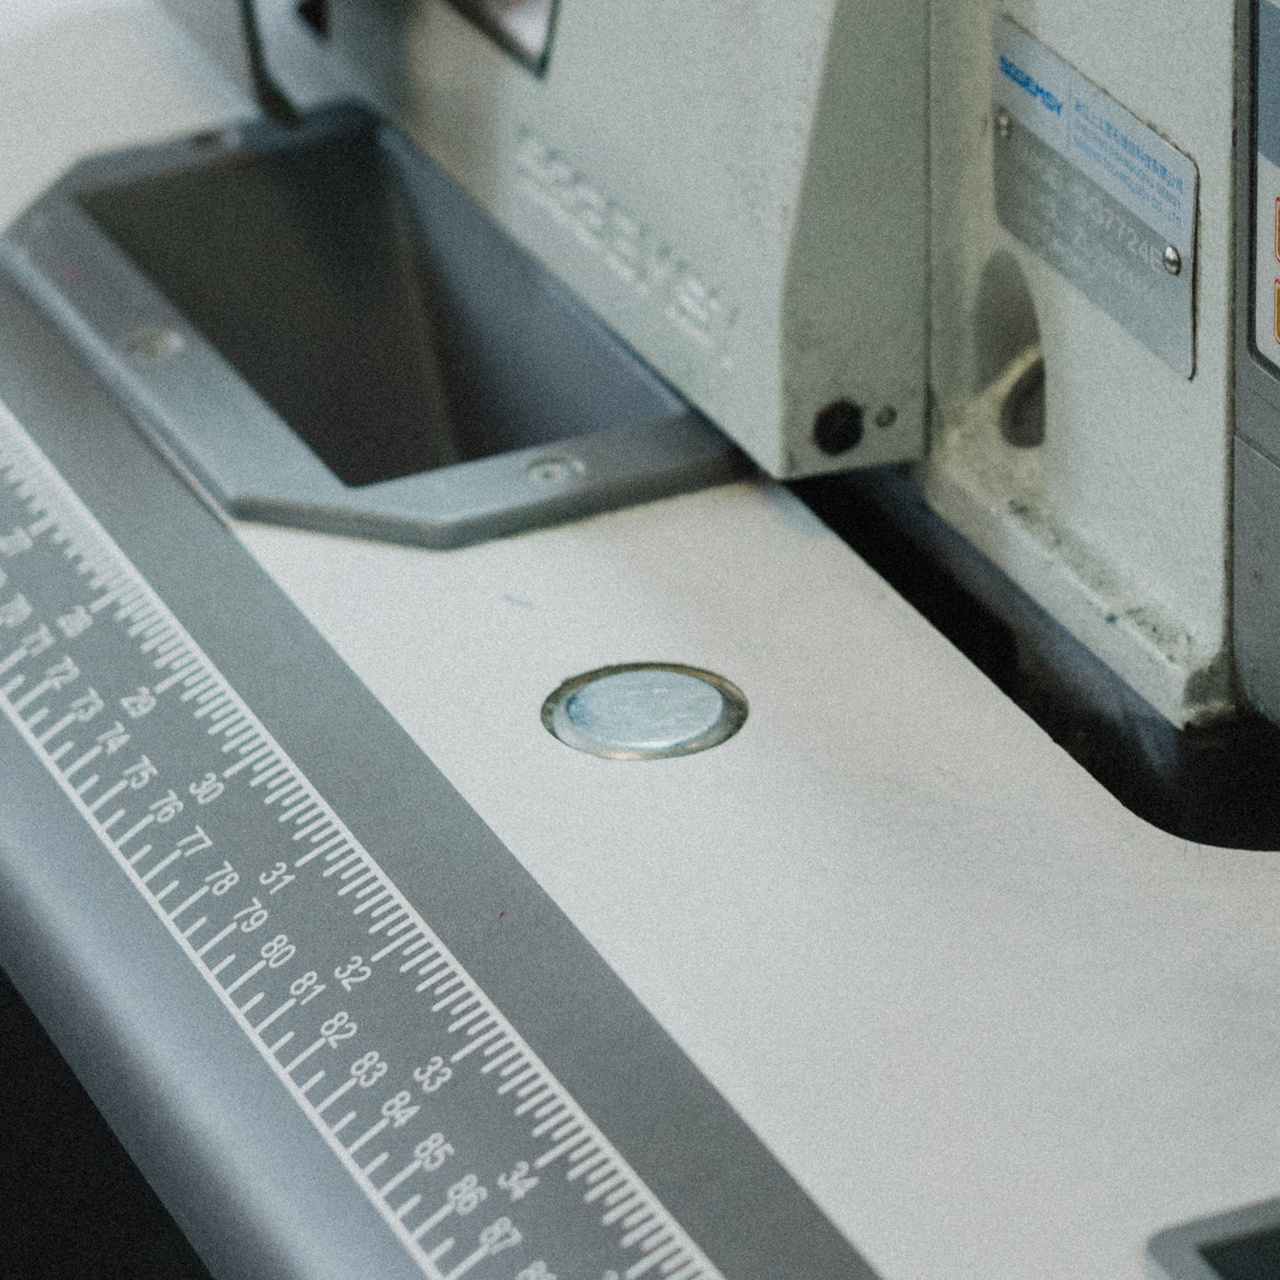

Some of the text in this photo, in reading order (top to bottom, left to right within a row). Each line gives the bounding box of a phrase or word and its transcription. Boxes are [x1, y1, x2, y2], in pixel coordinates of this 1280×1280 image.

[97, 721, 130, 755] 74
[123, 755, 158, 790] 75
[189, 773, 225, 804] 30
[150, 789, 184, 823] 76
[176, 825, 213, 857] 77
[204, 861, 239, 896] 78
[258, 861, 295, 895] 31
[232, 897, 269, 933] 79
[260, 934, 296, 968] 80
[290, 970, 326, 1006] 81
[334, 955, 372, 991] 32
[320, 1011, 358, 1048] 82
[350, 1050, 388, 1088] 83
[414, 1055, 452, 1093] 33
[381, 1090, 420, 1128] 84
[413, 1132, 455, 1170] 85
[447, 1173, 487, 1214] 86
[499, 1160, 539, 1202] 34
